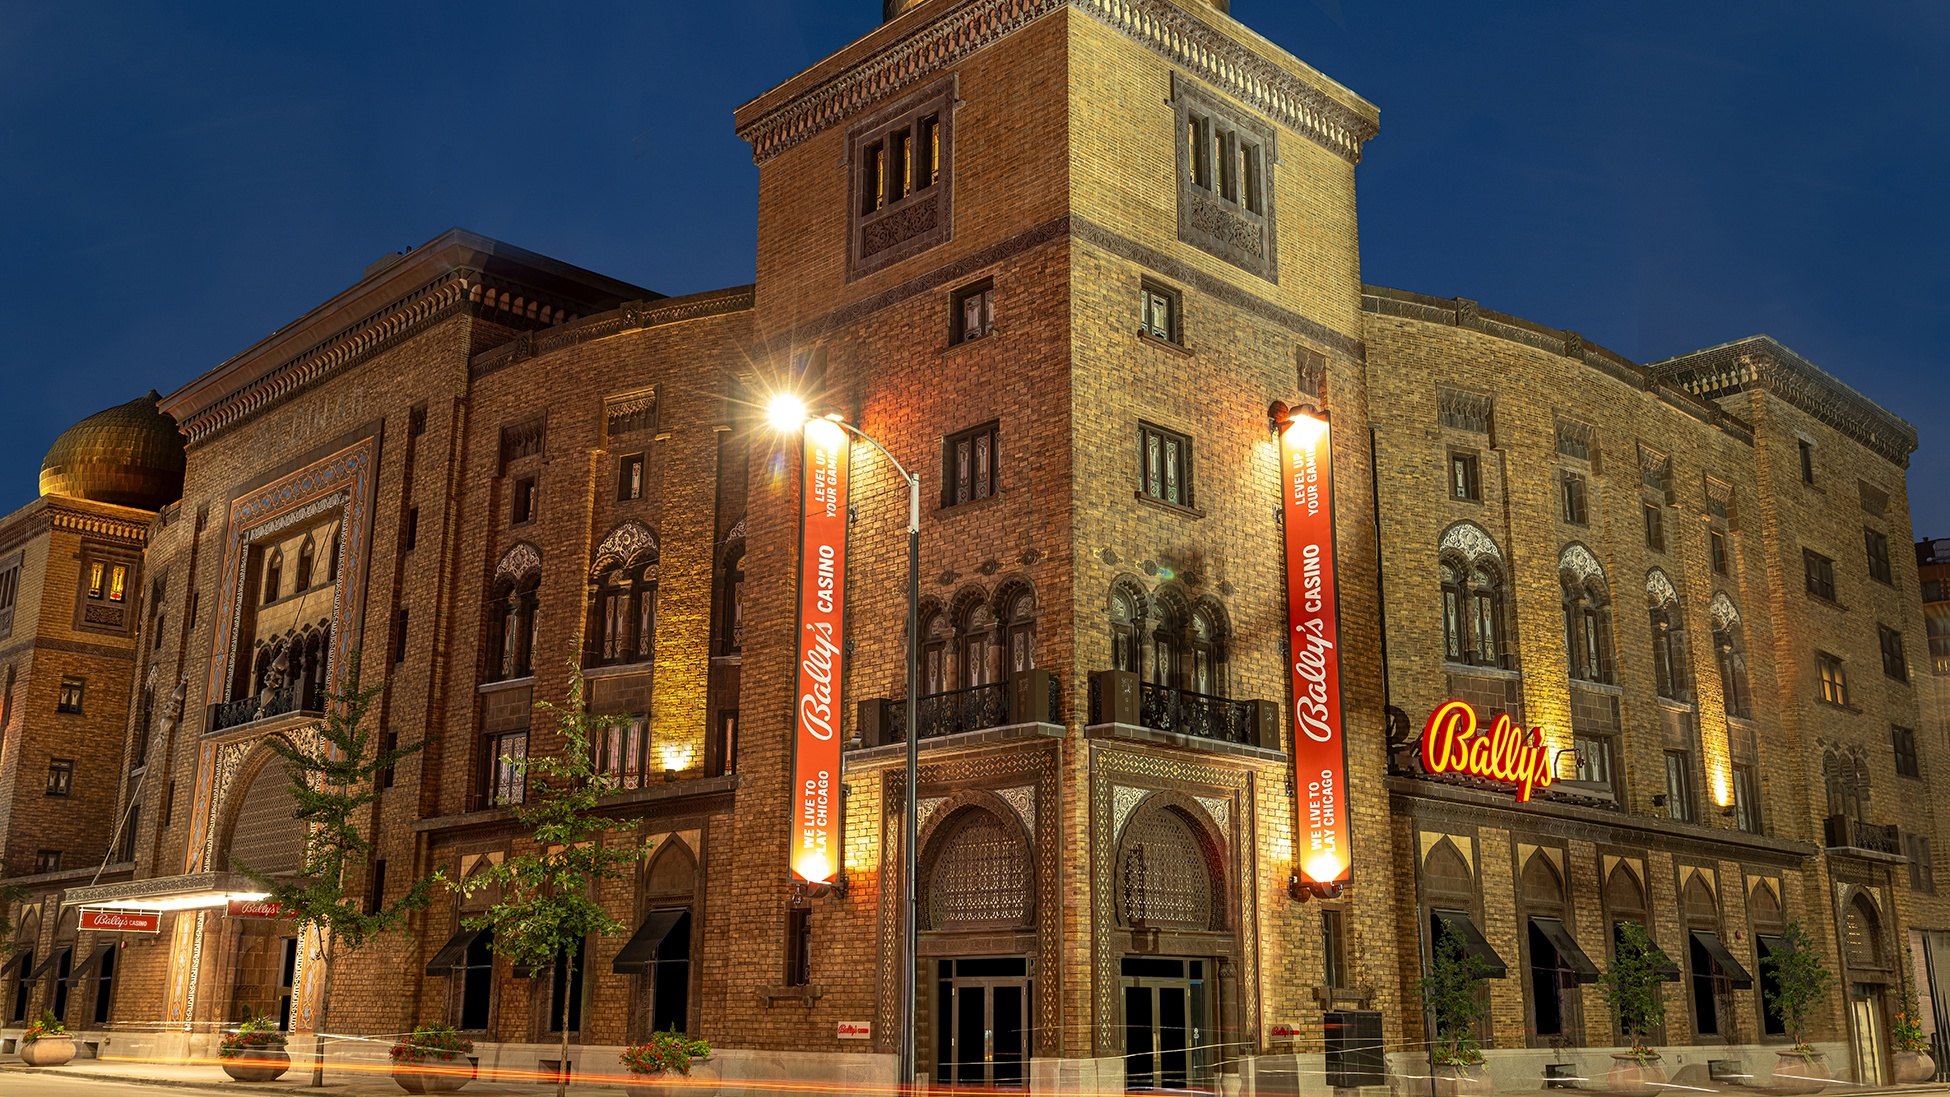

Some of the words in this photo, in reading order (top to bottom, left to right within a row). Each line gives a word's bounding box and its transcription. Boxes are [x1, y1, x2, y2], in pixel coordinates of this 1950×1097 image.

[815, 448, 826, 466] UP
[1292, 453, 1304, 469] UP
[815, 467, 825, 502] LEVEL
[1293, 469, 1306, 505] LEVEL
[826, 487, 837, 518] YOUR
[1307, 484, 1319, 517] YOUR
[817, 544, 834, 613] CASINO
[1303, 544, 1321, 613] CASINO
[801, 621, 840, 741] Bally's
[1295, 617, 1334, 743] Bally's
[1422, 700, 1552, 803] Bally's
[805, 780, 816, 796] TO
[817, 771, 829, 827] CHICAGO
[1308, 782, 1320, 799] TO
[1321, 769, 1335, 827] CHICAGO
[805, 799, 815, 826] LIVE
[1309, 800, 1321, 828] LIVE
[804, 829, 815, 849] WE
[816, 829, 827, 857] LAY
[1311, 830, 1322, 851] WE
[1323, 829, 1336, 856] LAY
[93, 914, 128, 927] Bally's
[241, 902, 275, 916] Bally's
